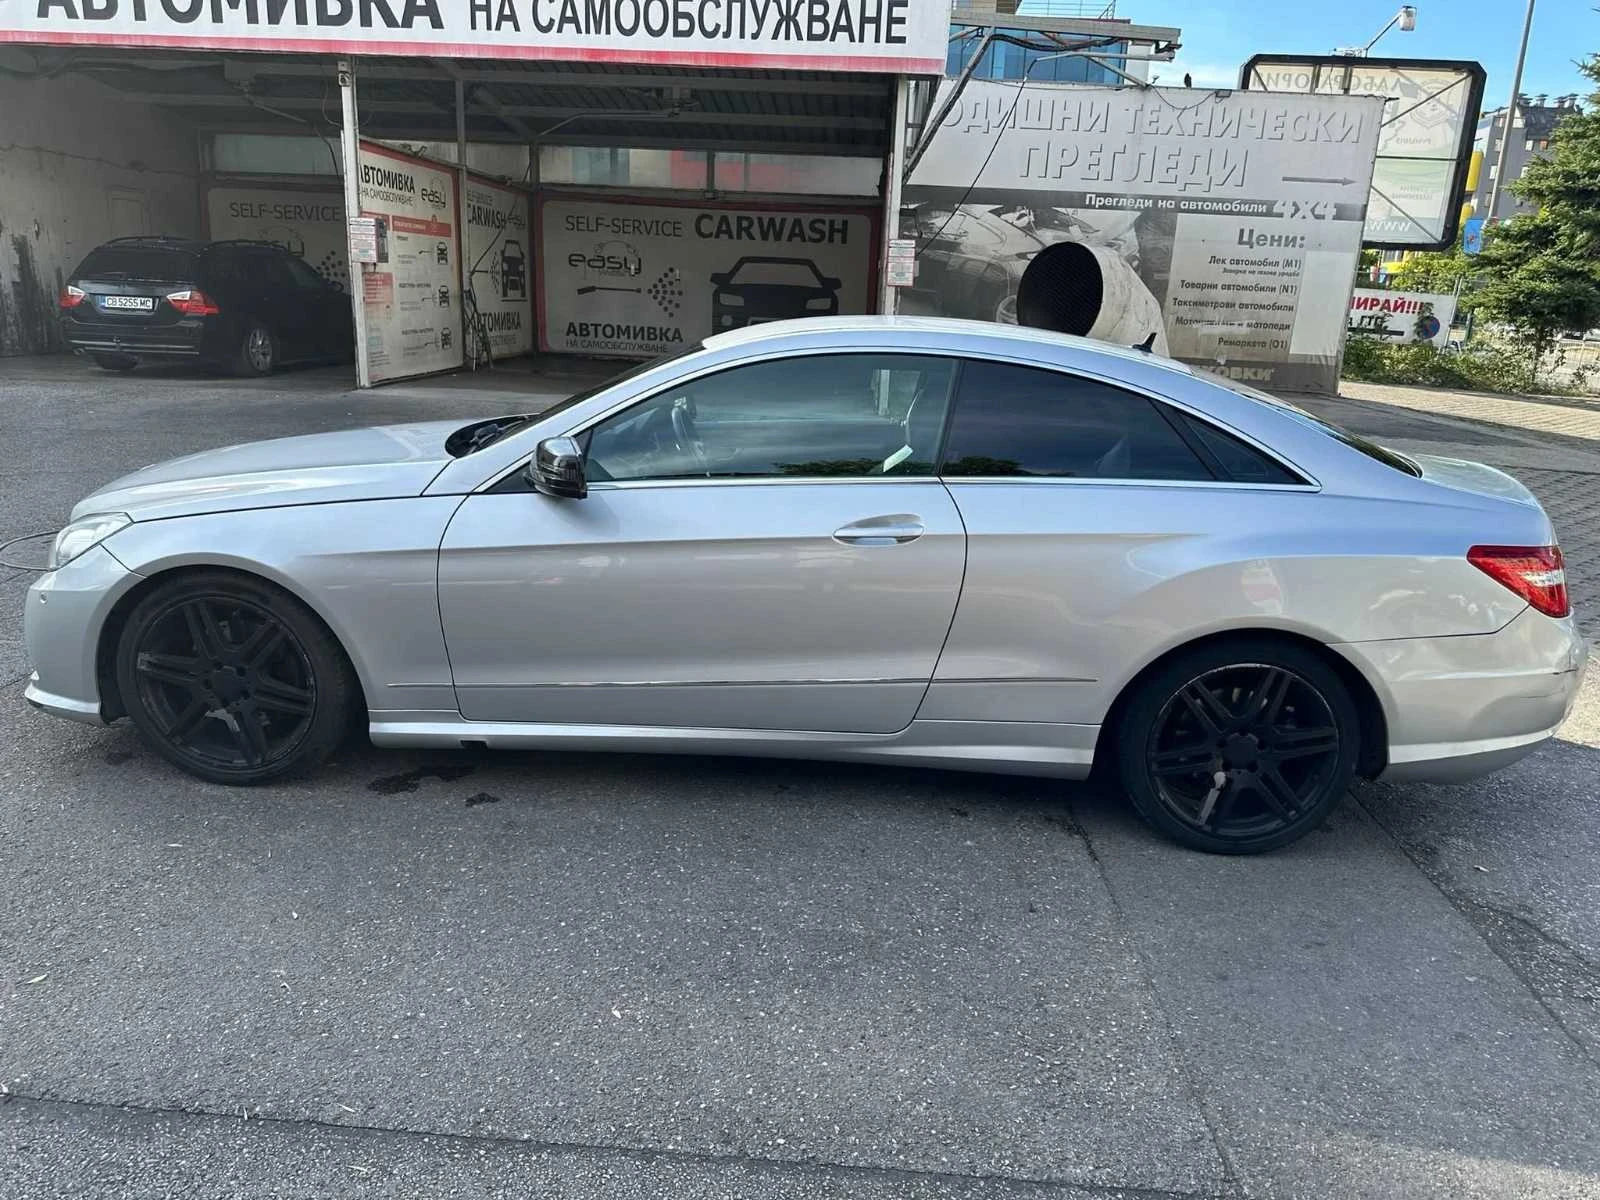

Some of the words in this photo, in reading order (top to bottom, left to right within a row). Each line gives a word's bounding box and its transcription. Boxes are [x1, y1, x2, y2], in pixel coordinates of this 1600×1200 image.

[470, 0, 521, 32] НА
[532, 0, 908, 44] САМООБСЛУЖВАНЕ
[1124, 100, 1363, 145] ТЕХНИЧЕСКИ
[1019, 139, 1249, 192] ПРЕГЛЕДИ
[229, 202, 340, 220] SELF-SERVICE
[1085, 193, 1153, 208] Прегледи
[1158, 200, 1175, 209] на
[1180, 199, 1267, 213] автомобили
[565, 215, 683, 237] SELF-SERVICE
[694, 213, 849, 245] CARWASH
[1237, 227, 1306, 249] Цени:
[1208, 255, 1227, 265] Лек
[1229, 257, 1280, 268] автомобил
[1180, 280, 1218, 292] Товарни
[1220, 282, 1277, 293] автомобили
[1279, 284, 1298, 295] (N1)
[1238, 300, 1295, 312] автомобили
[566, 322, 684, 343] АВТОМИВКА
[1246, 320, 1291, 331] мотопеди
[566, 339, 578, 348] НА
[579, 340, 668, 353] САМООБСЛУЖВАНЕ
